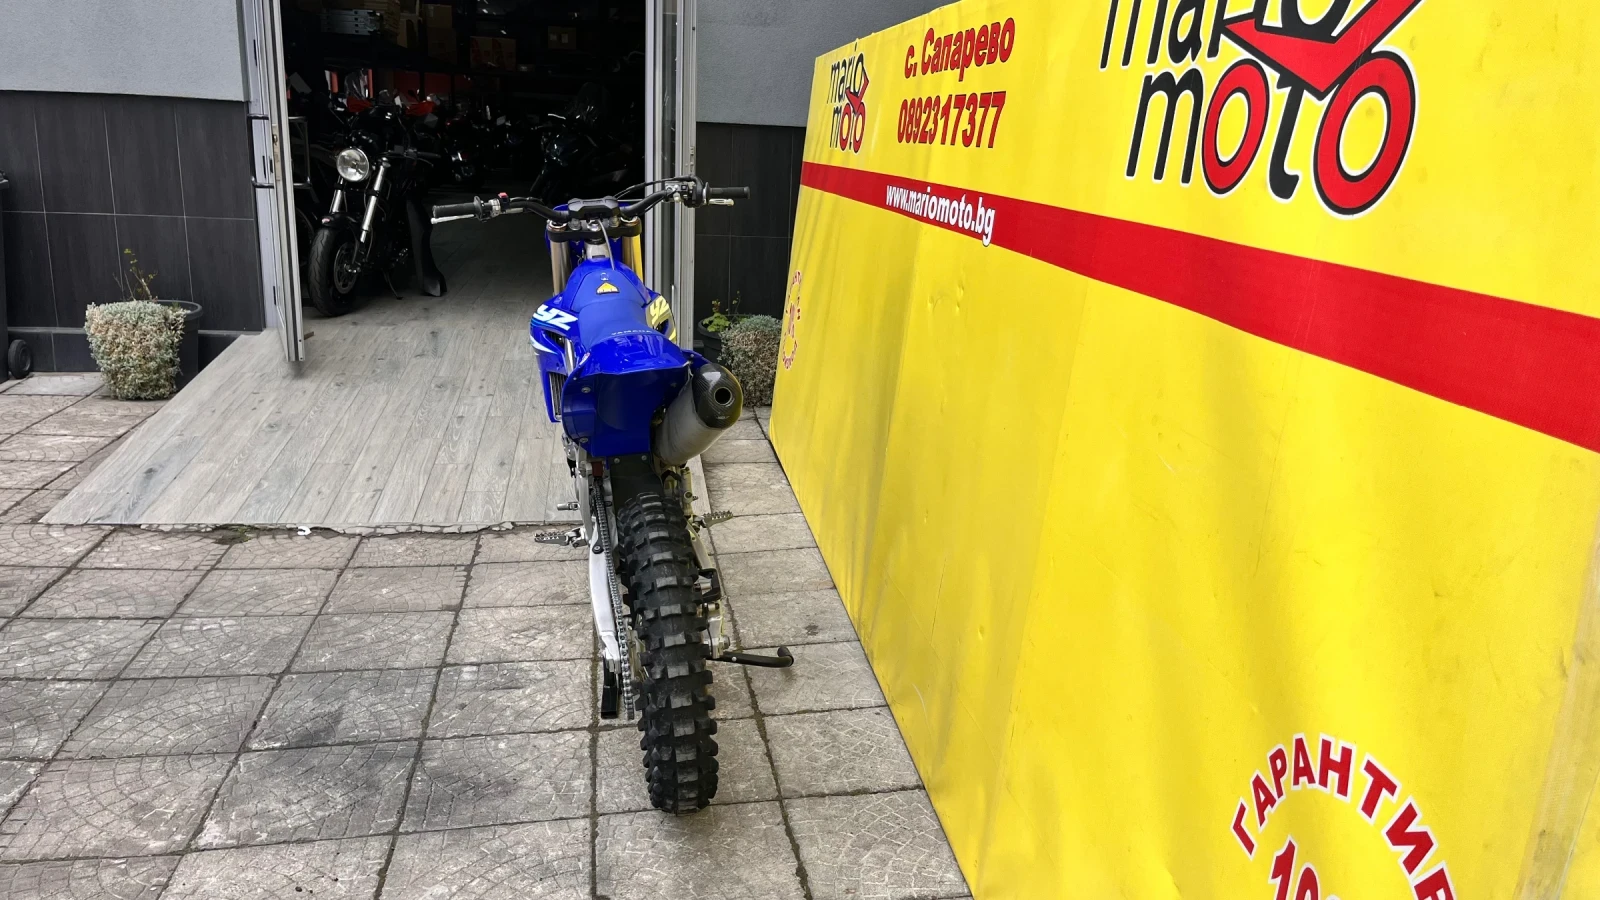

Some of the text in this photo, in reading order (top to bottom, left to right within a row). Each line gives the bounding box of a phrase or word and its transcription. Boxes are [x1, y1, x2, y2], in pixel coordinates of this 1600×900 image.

[921, 17, 1015, 82] Сапарево
[897, 91, 1006, 148] 0892317377
[1126, 49, 1416, 216] moto
[886, 185, 995, 247] www.mariomoto.bg
